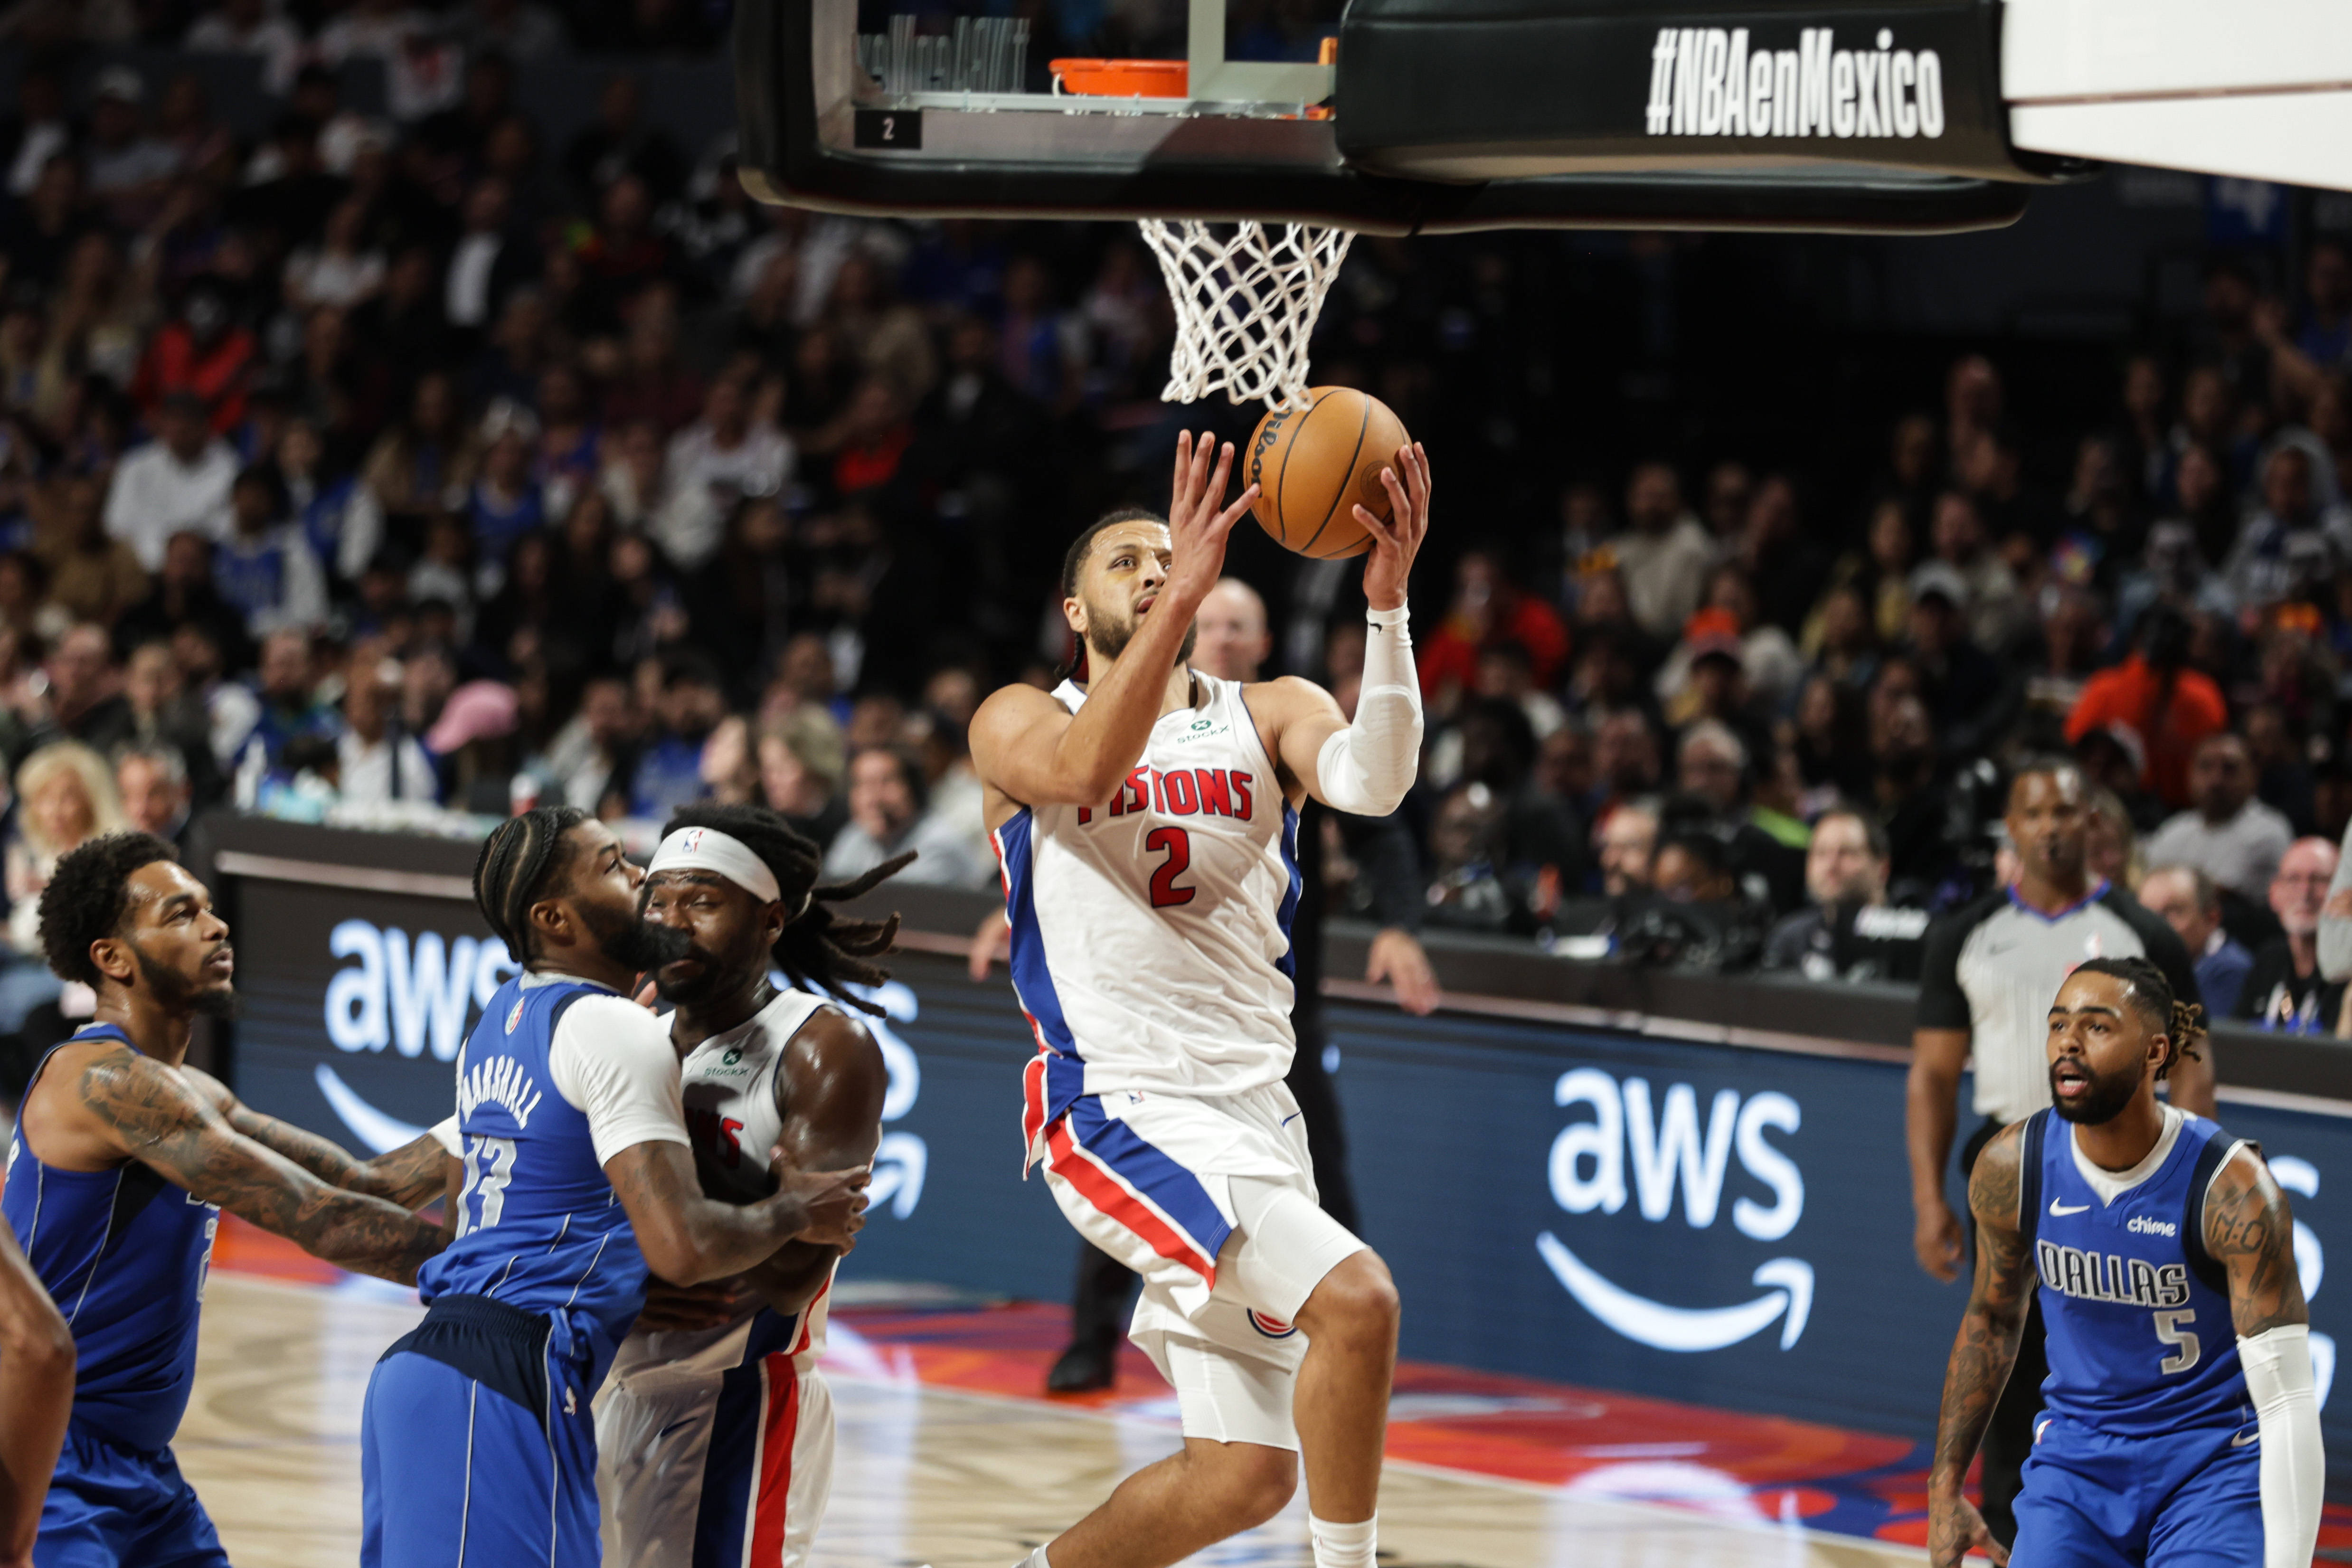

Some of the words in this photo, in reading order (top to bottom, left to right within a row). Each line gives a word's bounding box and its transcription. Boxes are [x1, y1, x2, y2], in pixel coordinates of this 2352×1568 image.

[1646, 27, 1944, 138] #NBAenMexico
[883, 117, 895, 140] 2
[1251, 406, 1294, 498] ilso
[1146, 826, 1196, 908] 2
[461, 1054, 543, 1131] MARSHALL
[455, 1135, 517, 1241] 13
[1548, 1067, 1804, 1241] aws
[2127, 1215, 2176, 1237] chime
[2037, 1238, 2191, 1308] DALLAS
[2153, 1308, 2201, 1375] 5
